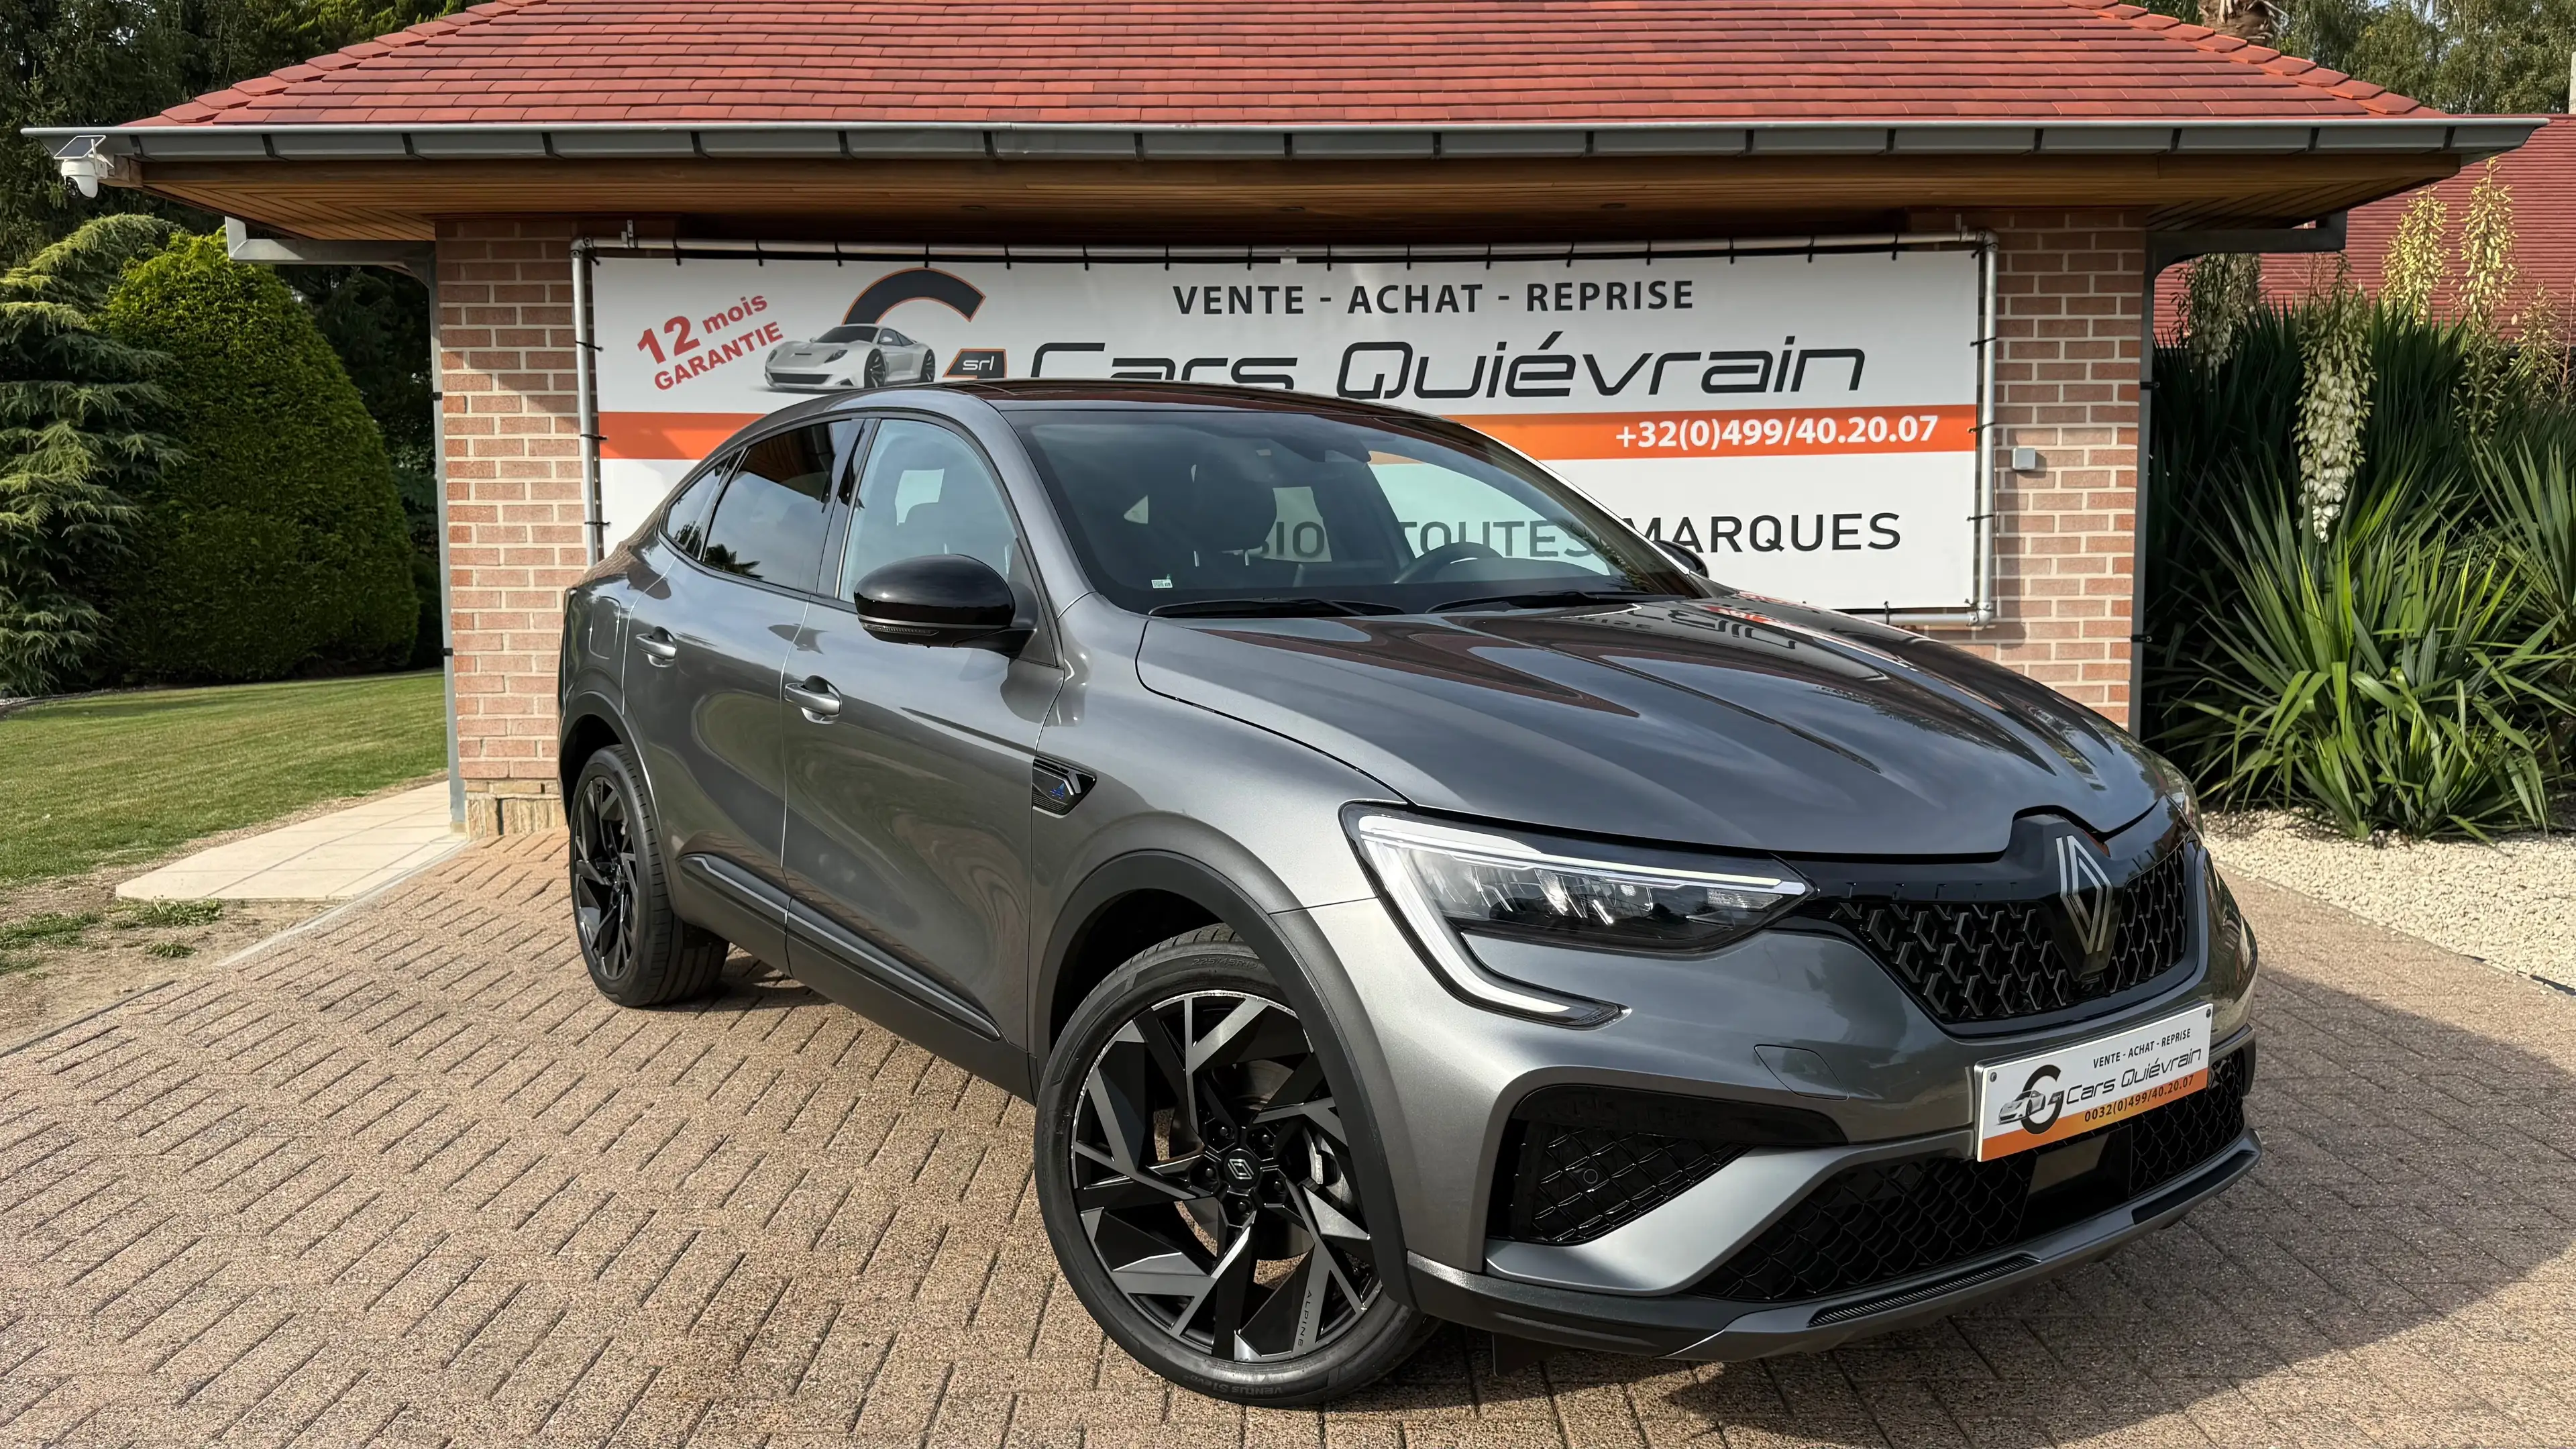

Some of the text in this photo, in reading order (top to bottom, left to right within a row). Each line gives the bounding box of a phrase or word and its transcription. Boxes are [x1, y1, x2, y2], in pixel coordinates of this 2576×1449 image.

[1173, 285, 1305, 315] VENTE
[1347, 284, 1483, 315] ACHAT
[1526, 280, 1694, 313] REPRISE
[637, 294, 768, 365] 12 mois
[654, 321, 784, 390] GARANTIE
[962, 355, 995, 371] srl
[1336, 330, 1866, 399] Quiévrain
[1615, 414, 1939, 452] +32(0)499/40.20.07
[2093, 1051, 2121, 1069] VENTE
[2127, 1040, 2155, 1059] ACHAT
[2161, 1028, 2191, 1047] REPRISE
[2066, 1048, 2202, 1105] Cars Quiévrain
[2084, 1075, 2194, 1122] 0032(0)499/40.20.07
[1297, 1289, 1312, 1347] ALPINE
